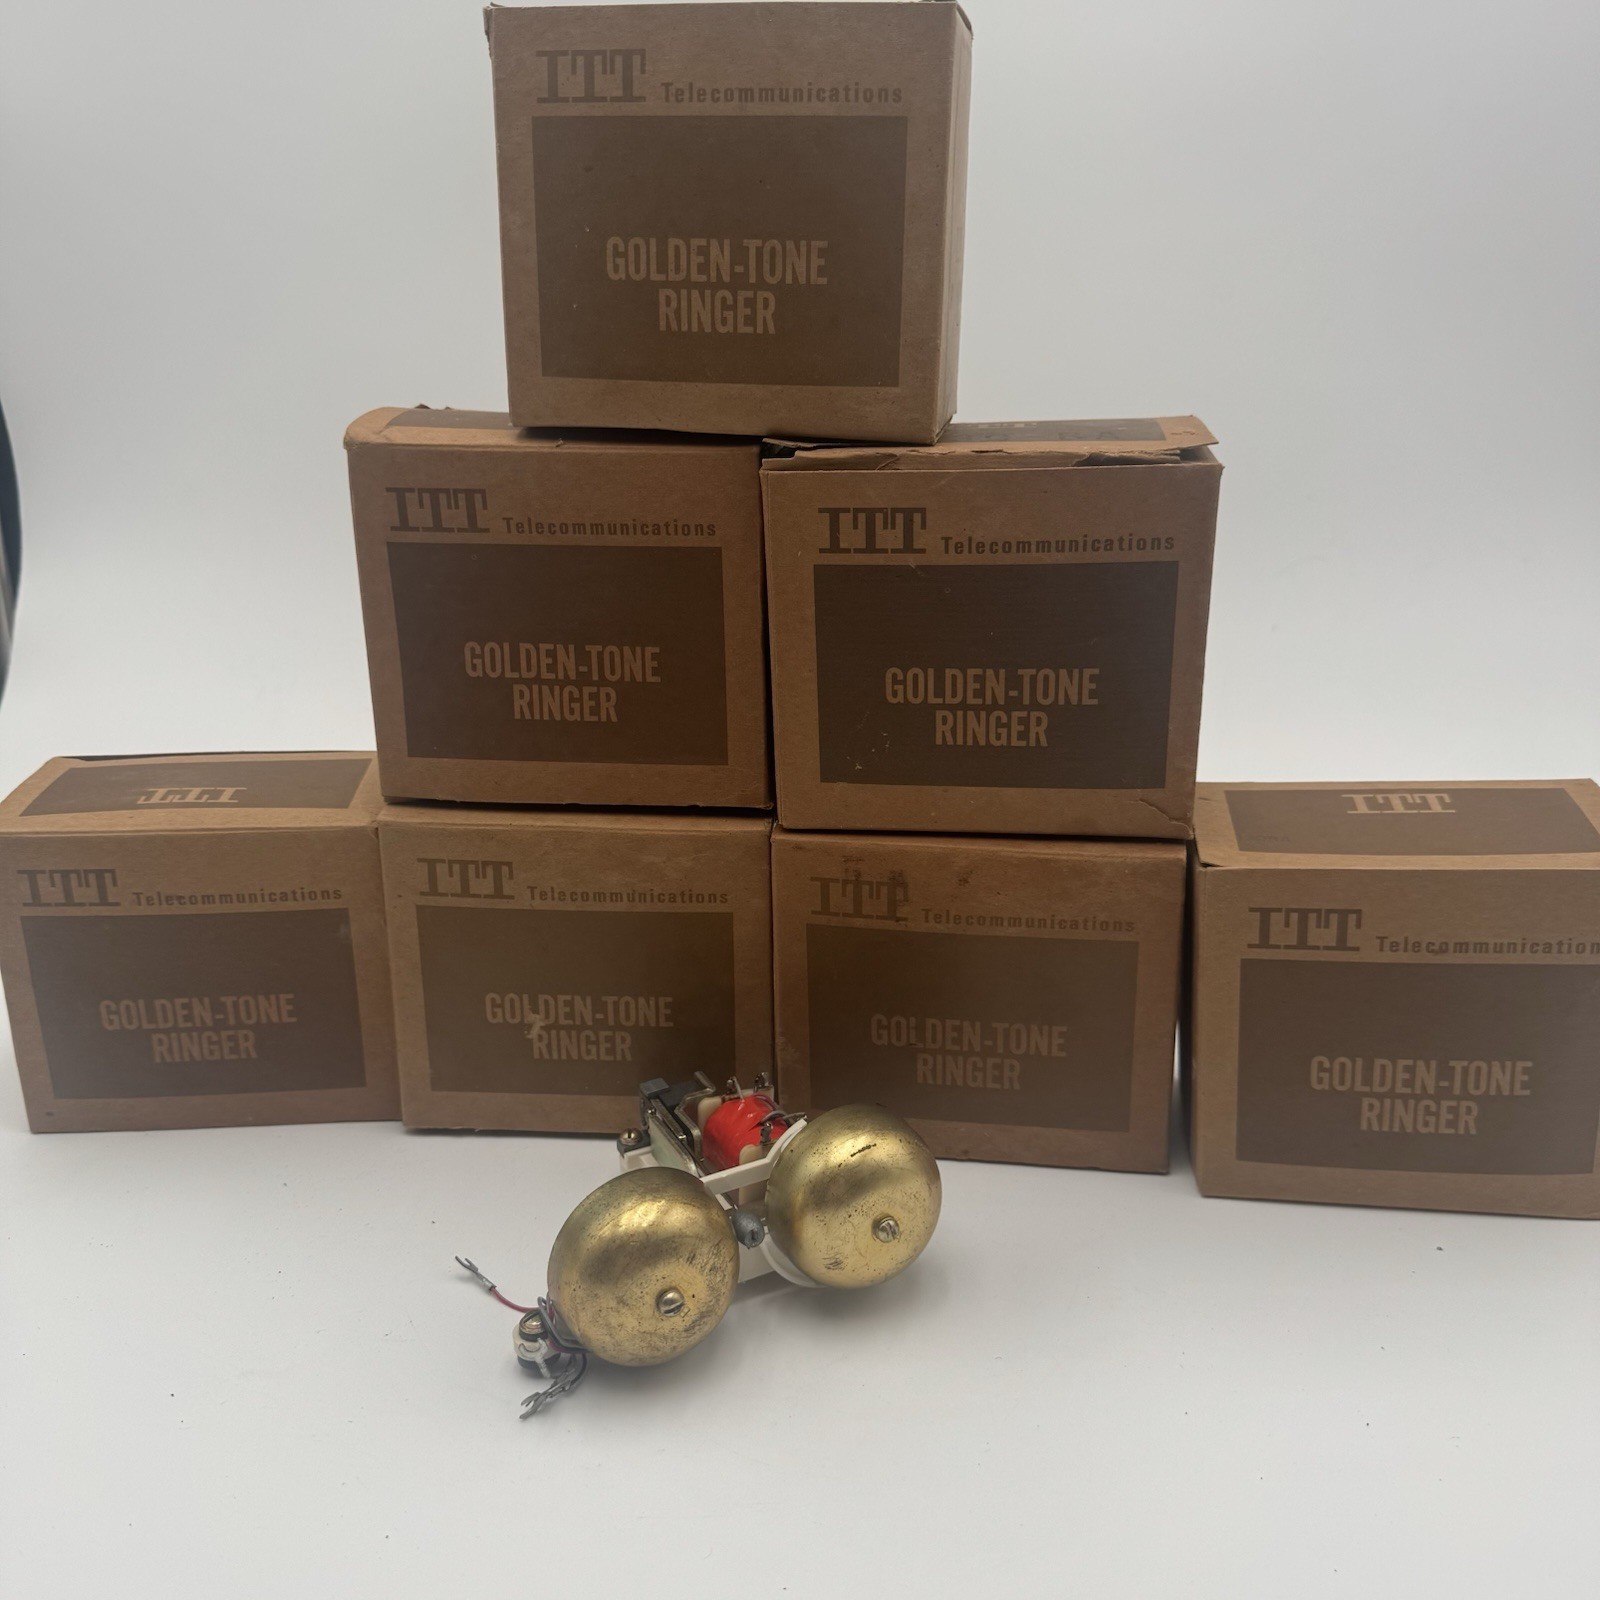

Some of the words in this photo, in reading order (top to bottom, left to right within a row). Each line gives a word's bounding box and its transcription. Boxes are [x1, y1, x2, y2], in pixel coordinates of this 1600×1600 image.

[536, 49, 646, 104] ITT
[662, 81, 903, 105] Telecommunications
[606, 236, 829, 285] GOLDEN-TONE
[658, 288, 776, 335] RINGER
[386, 487, 491, 534] ITT
[502, 517, 717, 538] Telecommunications
[818, 507, 927, 555] ITT
[941, 533, 1175, 556] Telecommunications
[464, 641, 662, 683] GOLDEN-TONE
[513, 684, 618, 723] RINGER
[885, 667, 1100, 706] GOLDEN-TONE
[935, 710, 1049, 748] RINGER
[1341, 793, 1456, 814] ITT
[17, 868, 121, 908] ITT
[132, 887, 342, 907] Telecommunications
[417, 857, 515, 900] ITT
[526, 885, 729, 904] Telecommunications
[810, 876, 909, 922] ITT
[921, 907, 1136, 933] Telecommunications
[1247, 906, 1363, 952] ITT
[100, 993, 297, 1031] GOLDEN-TONE
[485, 992, 674, 1027] GOLDEN-TONE
[151, 1029, 258, 1063] RINGER
[532, 1029, 633, 1062] RINGER
[870, 1013, 1067, 1057] GOLDEN-TONE
[916, 1052, 1021, 1090] RINGER
[1310, 1055, 1533, 1096] GOLDEN-TONE
[1360, 1097, 1479, 1135] RINGER
